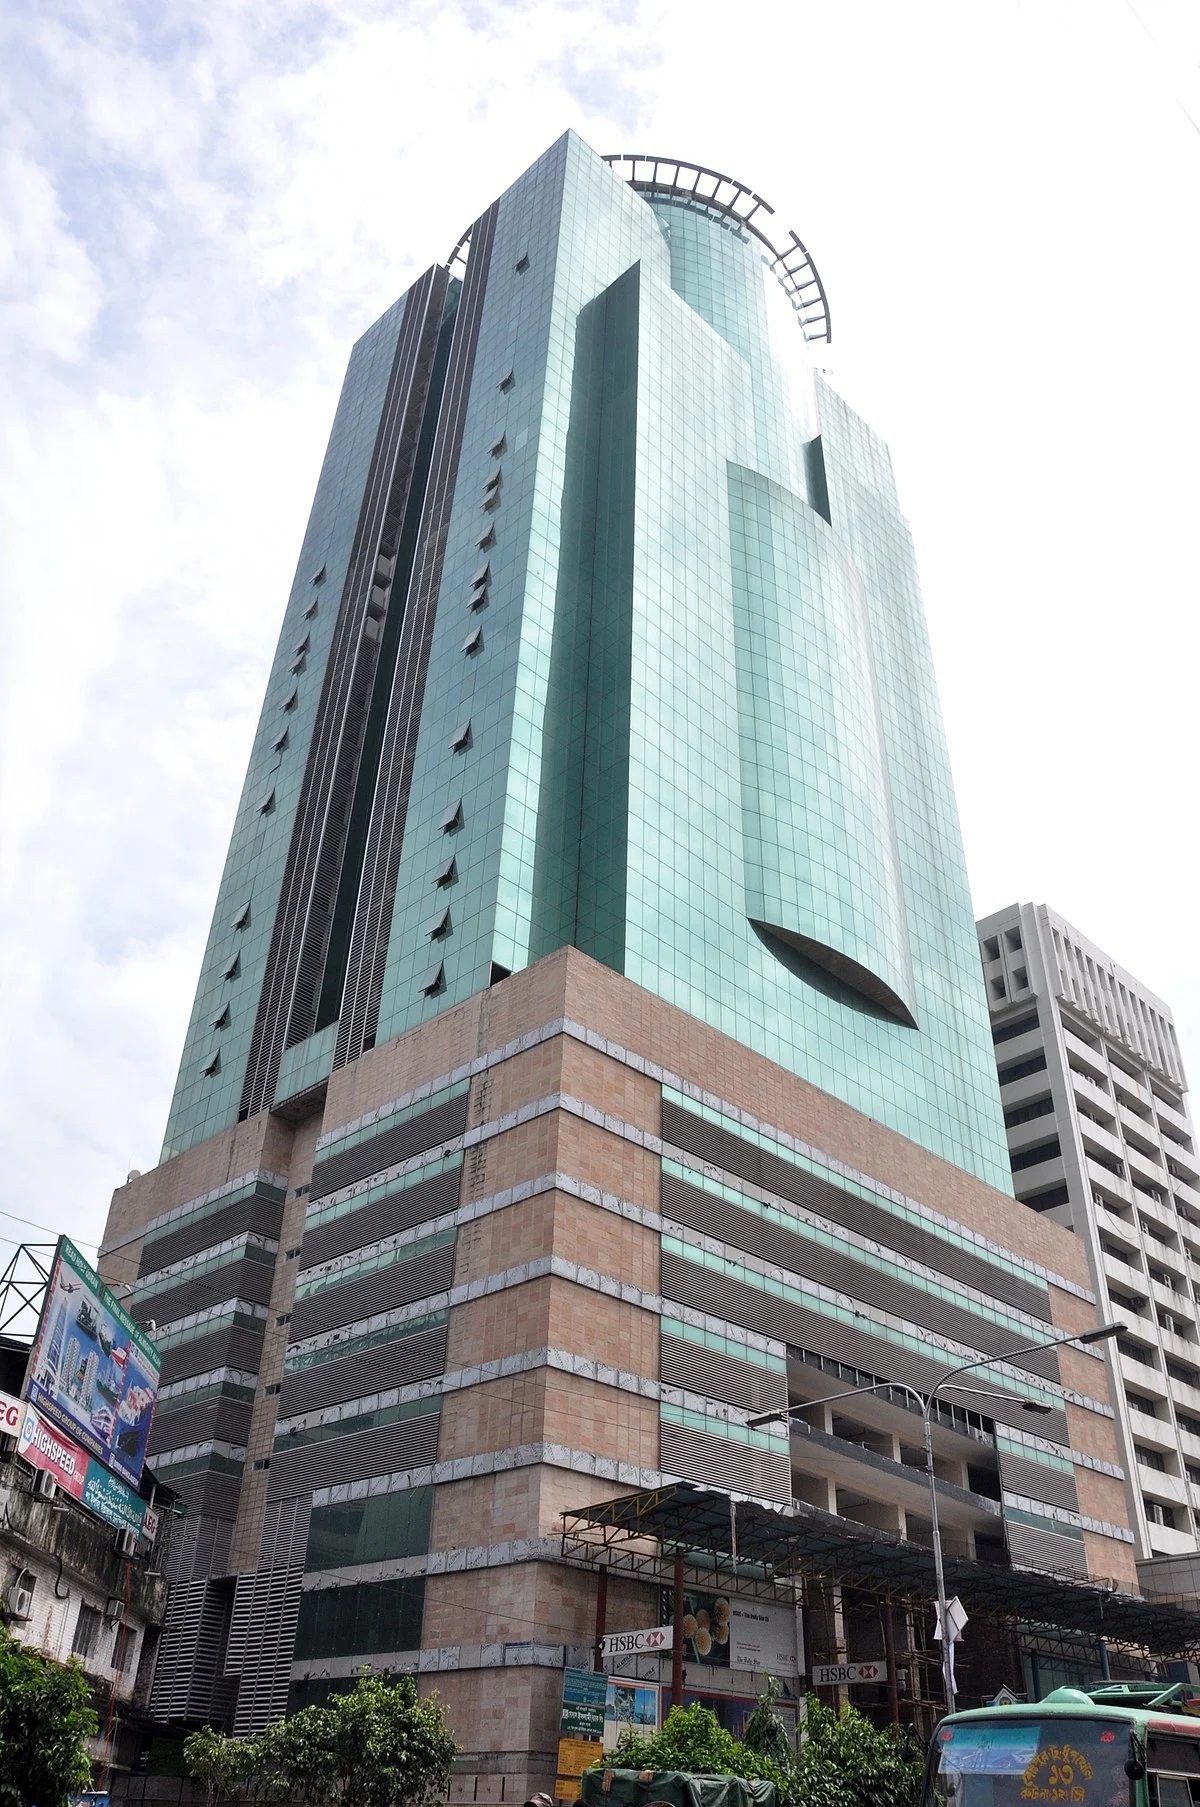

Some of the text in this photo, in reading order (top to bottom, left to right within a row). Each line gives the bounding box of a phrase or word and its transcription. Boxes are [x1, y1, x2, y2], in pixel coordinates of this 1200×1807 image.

[37, 1392, 104, 1455] HIGHSPEED GROUP OF COMPANIES
[31, 1427, 85, 1485] HIGHSPEED GROUP
[143, 1513, 156, 1534] AEG
[609, 1633, 644, 1653] HSBC
[819, 1666, 857, 1683] HSBC
